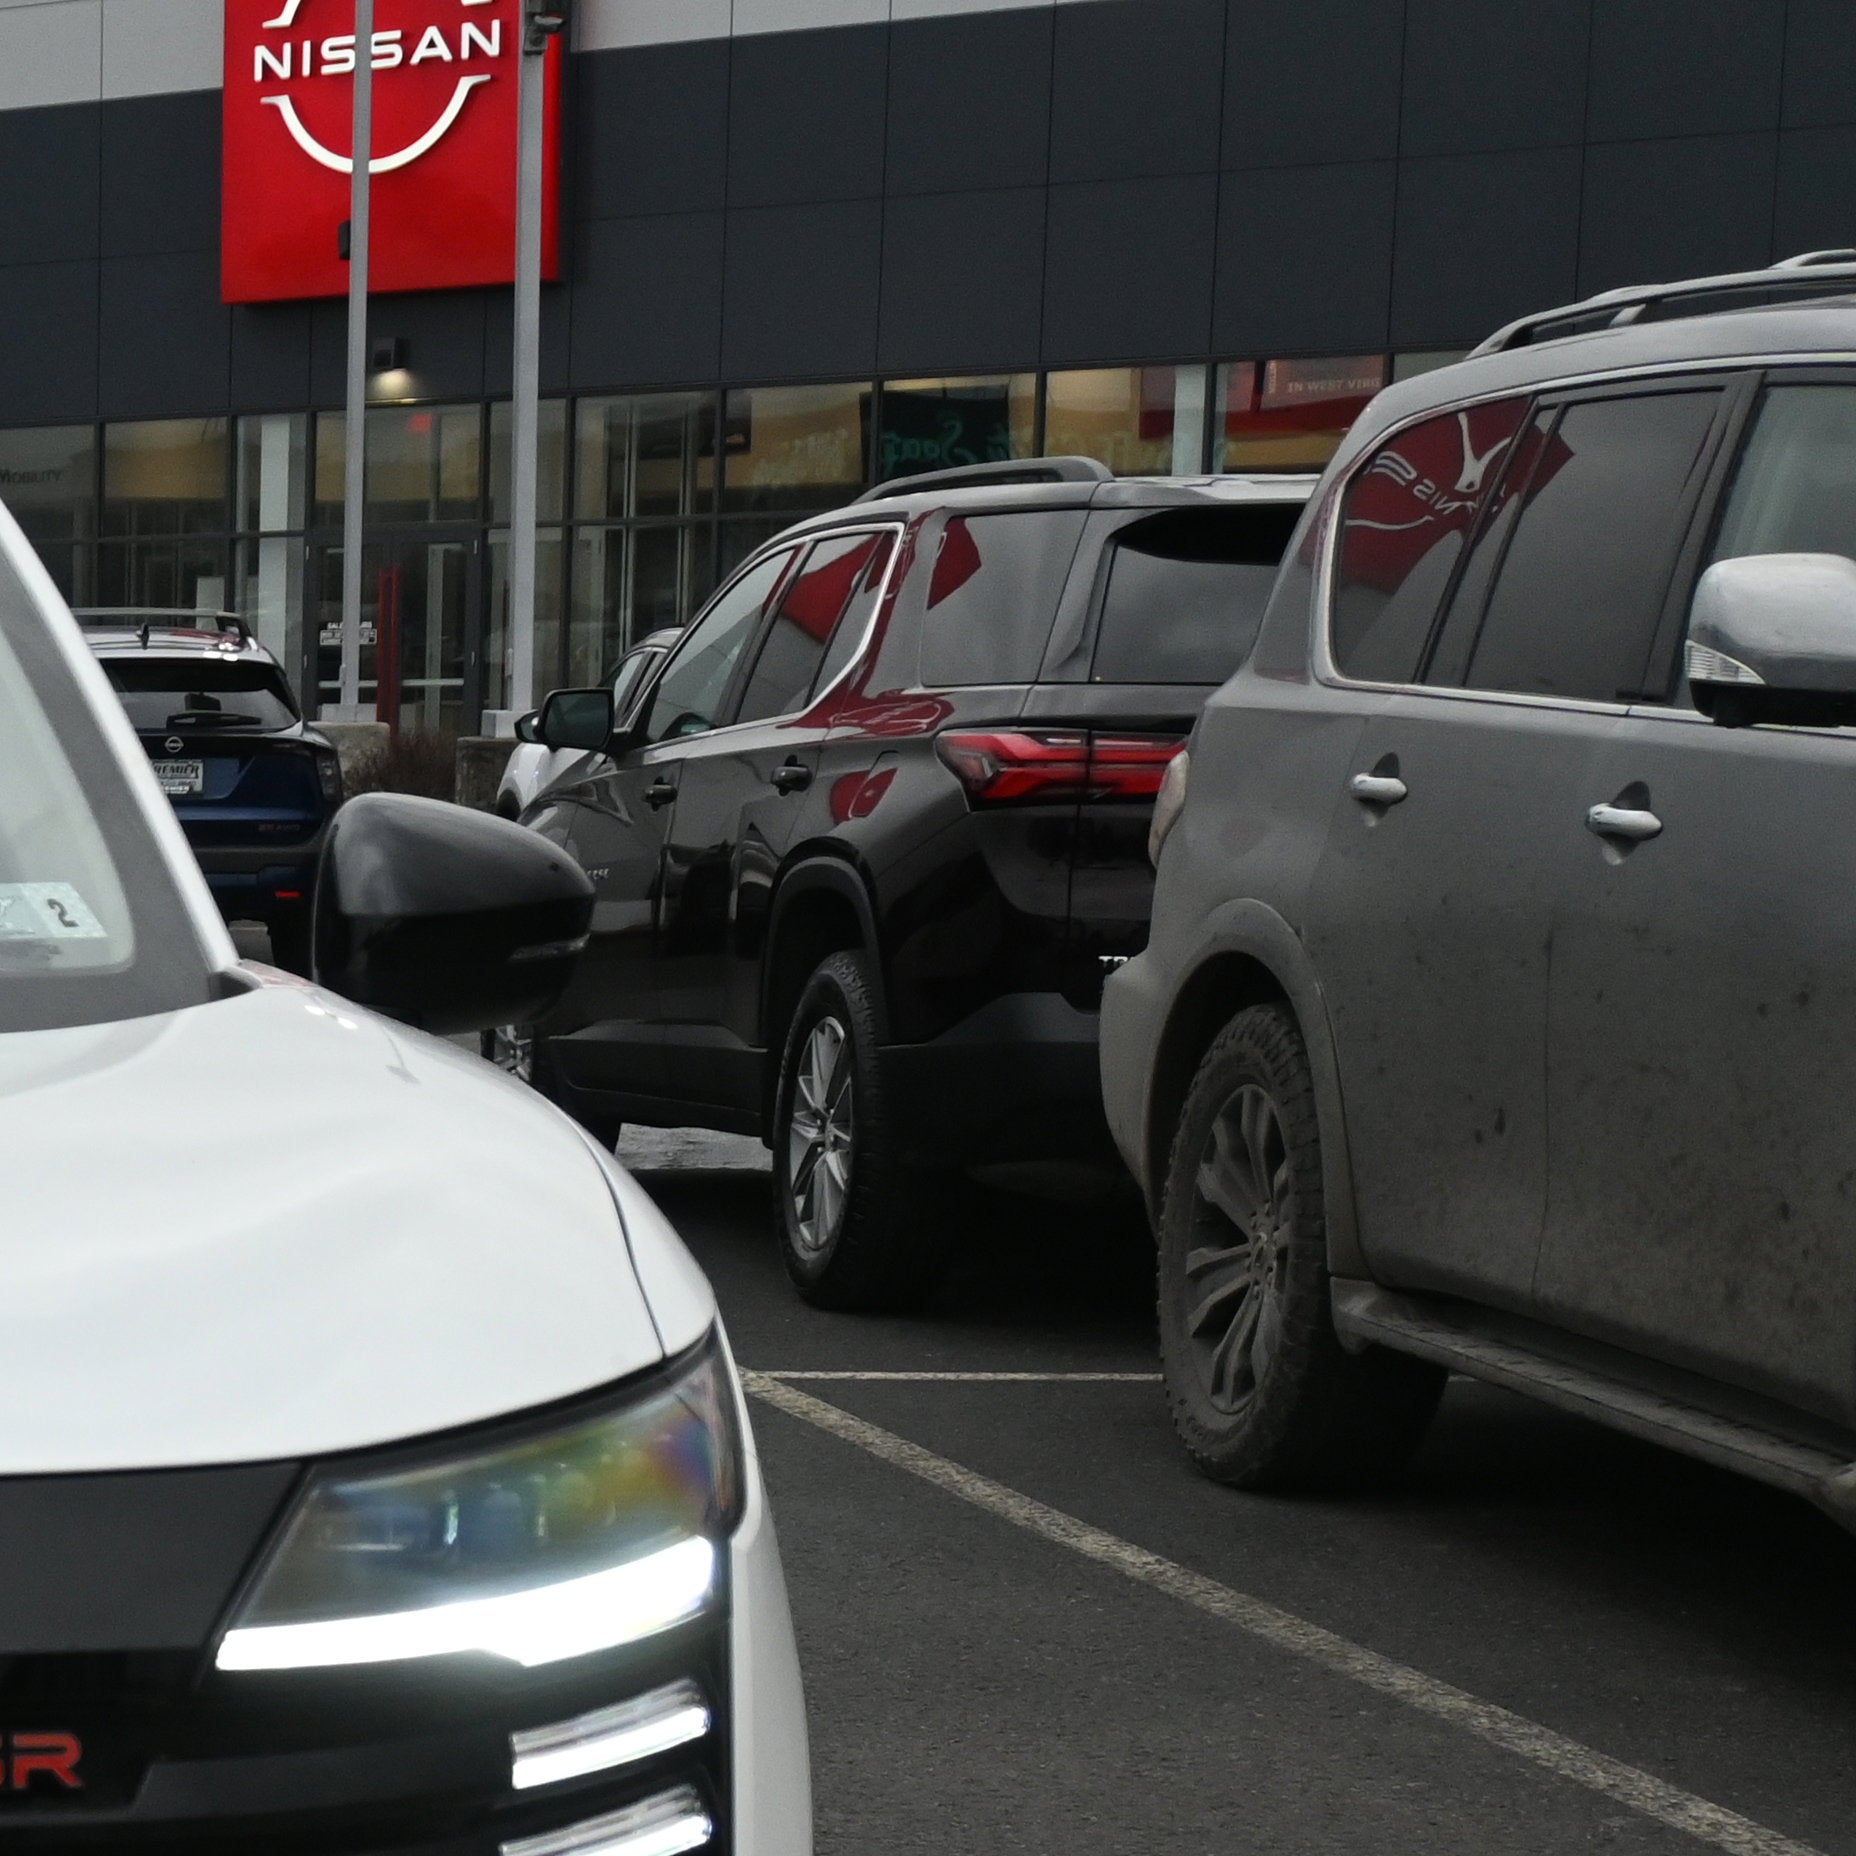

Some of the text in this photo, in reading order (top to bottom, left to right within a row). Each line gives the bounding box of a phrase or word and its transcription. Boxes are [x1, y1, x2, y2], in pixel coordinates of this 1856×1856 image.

[253, 18, 501, 83] NISSAN
[1347, 376, 1382, 390] VIRG
[46, 898, 79, 928] 2
